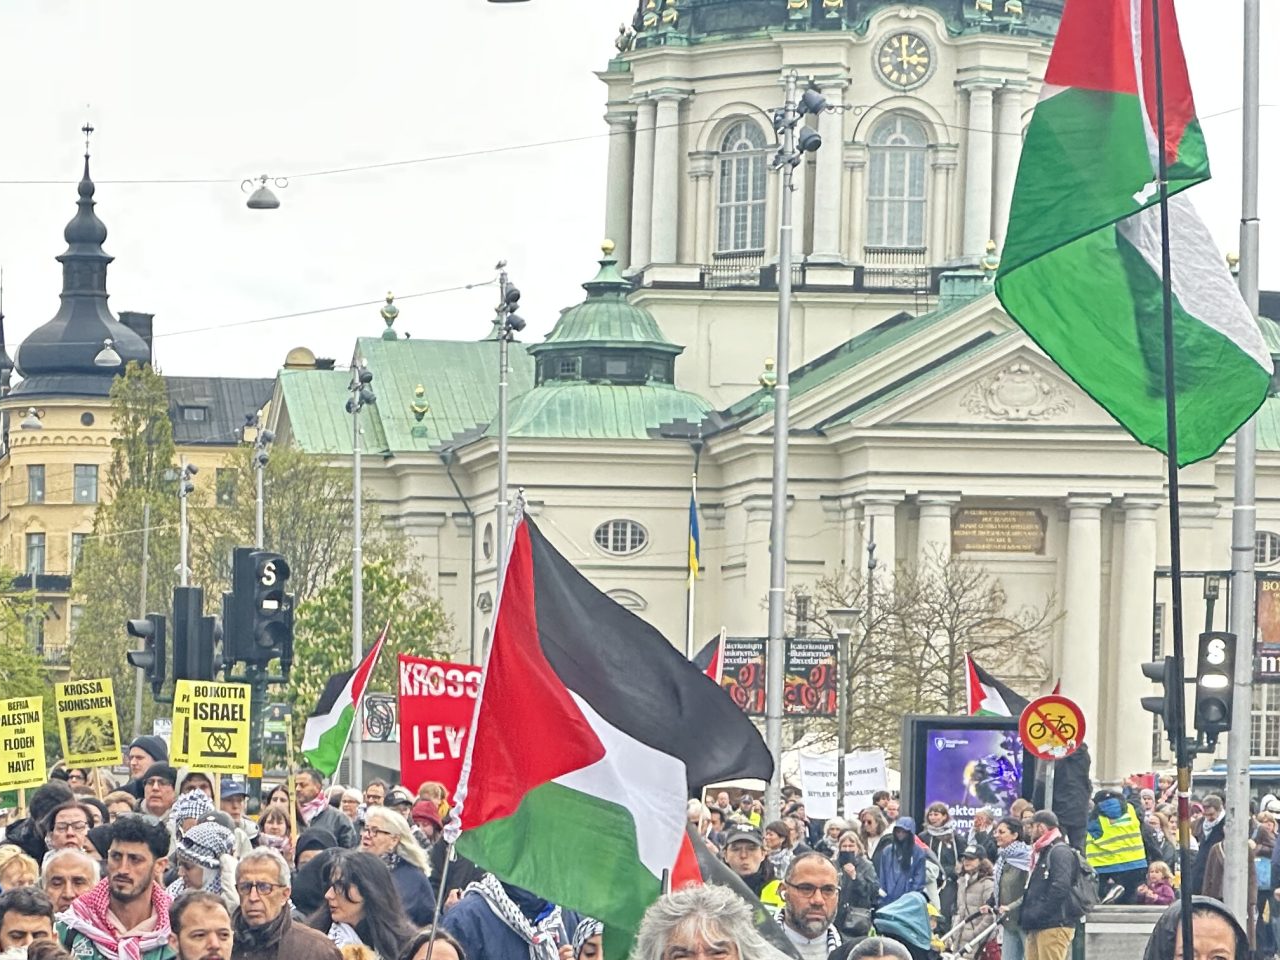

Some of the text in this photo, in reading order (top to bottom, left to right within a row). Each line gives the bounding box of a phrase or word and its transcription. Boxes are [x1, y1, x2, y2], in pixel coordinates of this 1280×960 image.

[261, 561, 277, 586] S
[1206, 638, 1226, 665] S
[63, 682, 103, 697] KROSSA
[194, 686, 246, 699] BOJKOTTA
[58, 696, 113, 713] SIONISMEN
[193, 702, 246, 722] ISRAEL
[4, 736, 35, 751] FLODEN
[7, 759, 35, 773] HAVET
